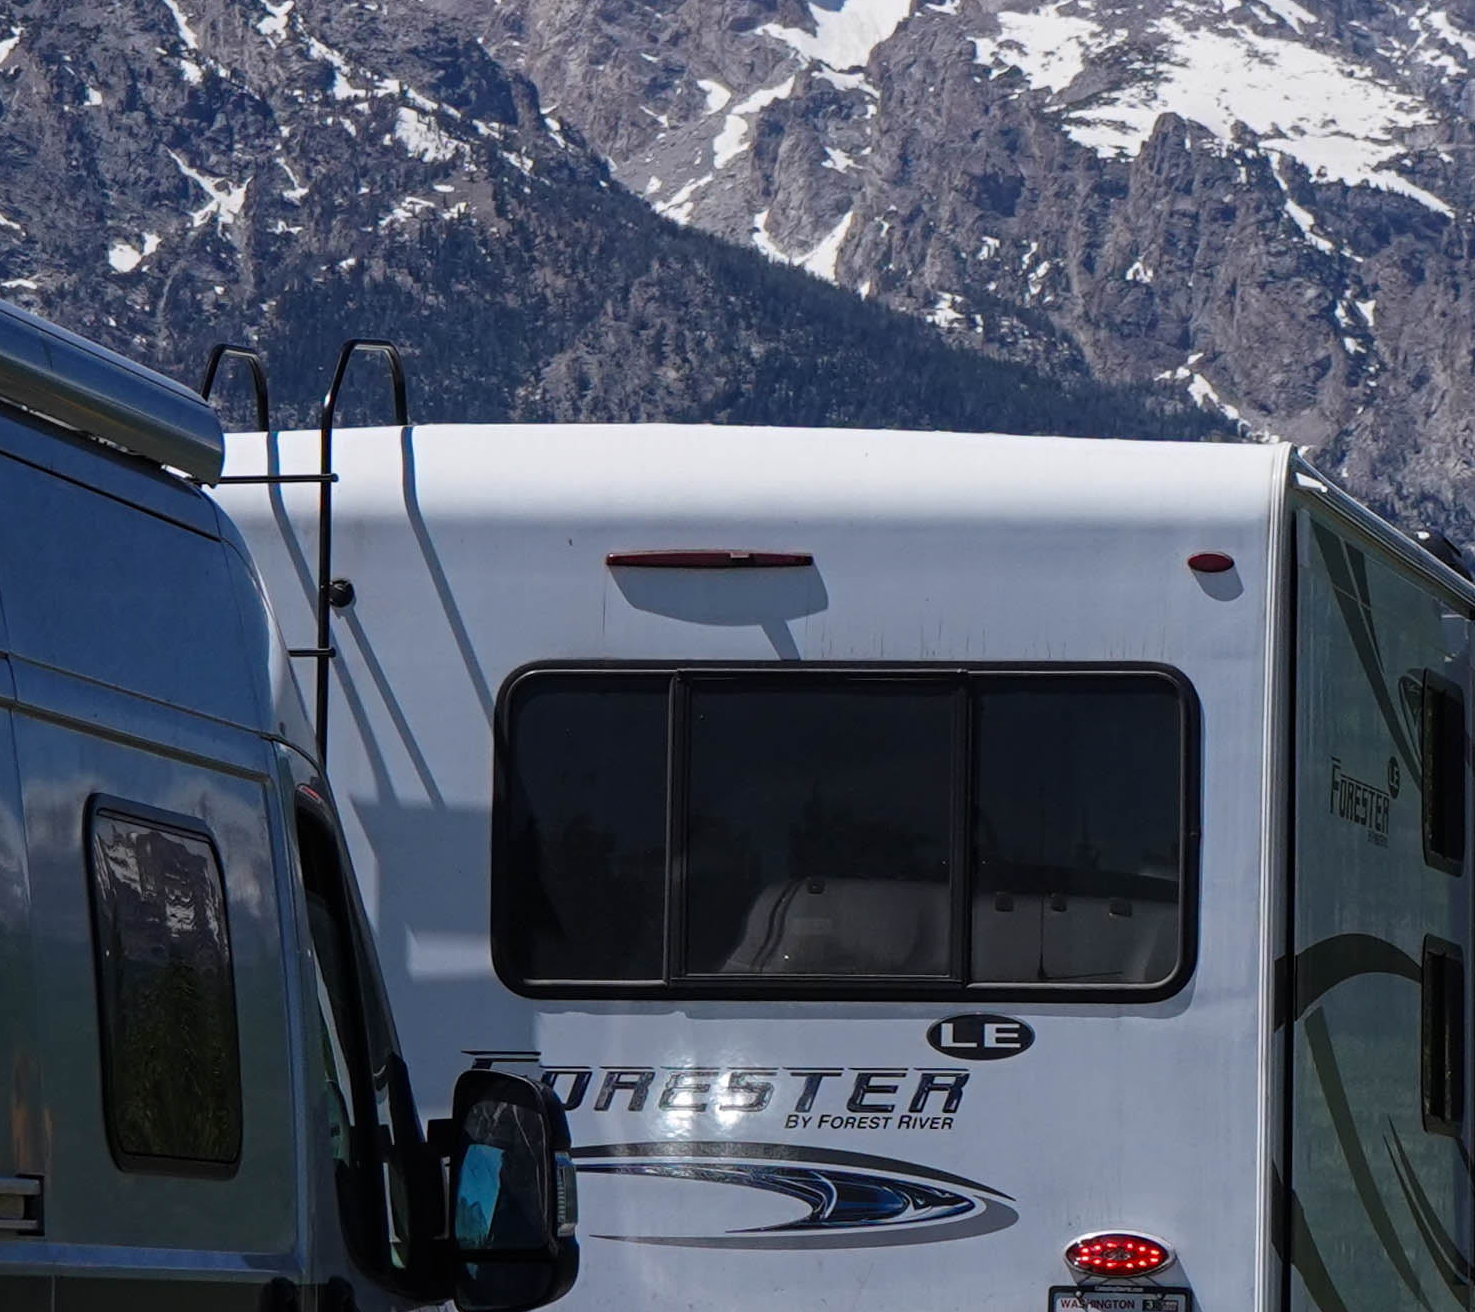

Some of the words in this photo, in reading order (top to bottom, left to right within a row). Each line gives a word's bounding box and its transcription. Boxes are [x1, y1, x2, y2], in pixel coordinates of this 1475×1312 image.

[1329, 755, 1390, 834] FORESTER
[940, 1023, 1021, 1048] LE
[817, 1115, 893, 1129] FOREST
[897, 1115, 955, 1130] RIVER
[1060, 1299, 1135, 1310] WASHINGTON
